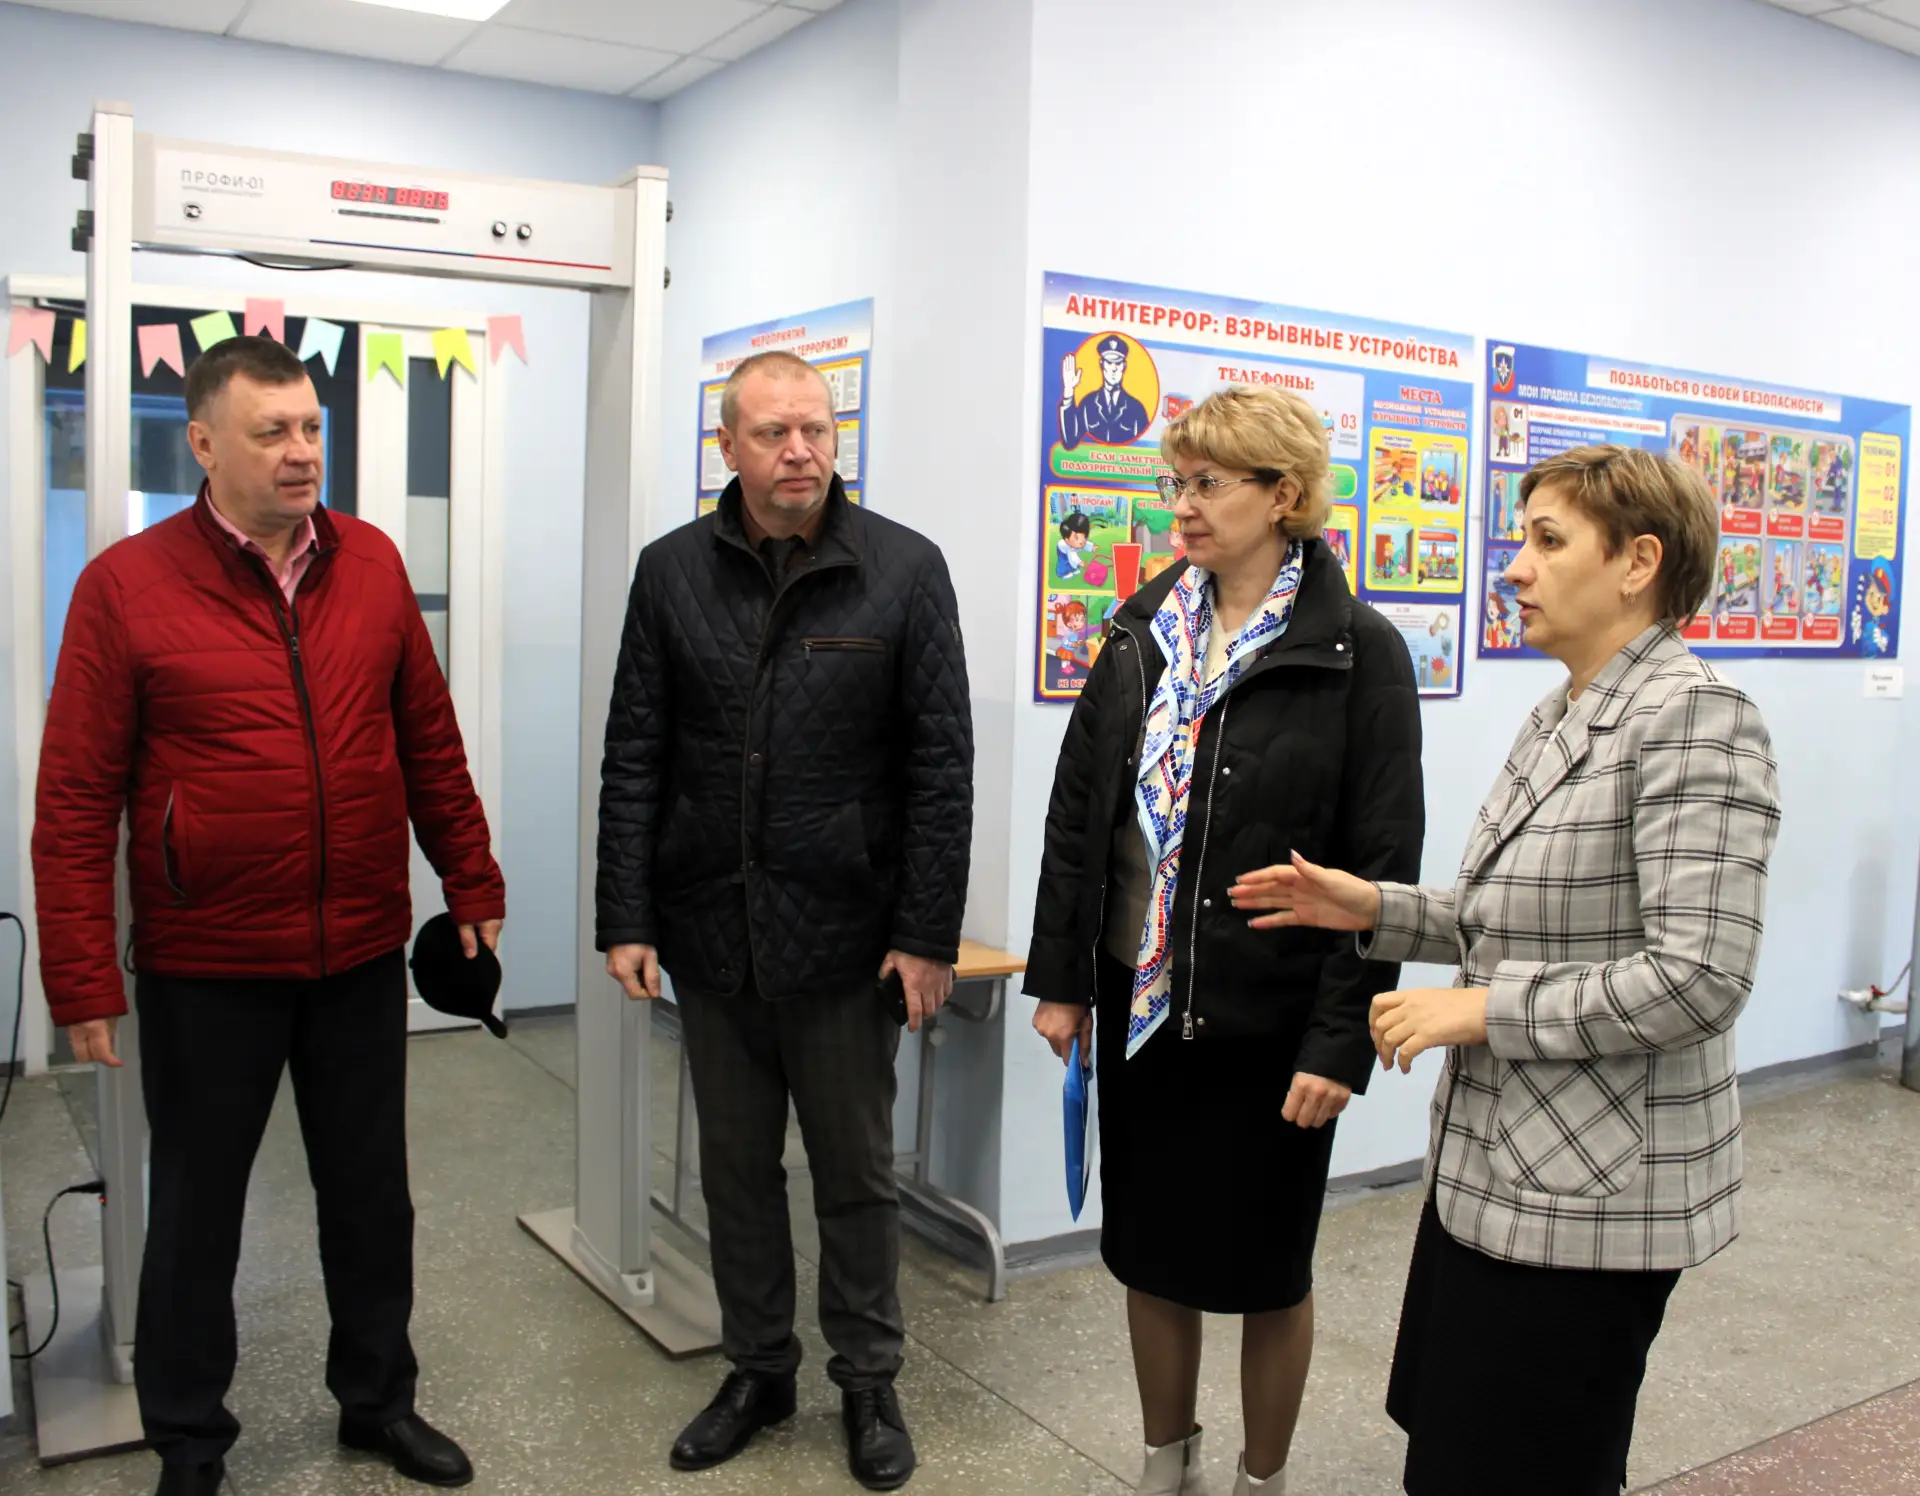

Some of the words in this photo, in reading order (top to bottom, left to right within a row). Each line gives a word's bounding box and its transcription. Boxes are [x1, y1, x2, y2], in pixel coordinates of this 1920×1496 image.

[181, 169, 264, 189] ПРОФИ-01
[1065, 294, 1218, 333] АНТИТЕРРОР:
[1225, 316, 1343, 350] ВЗРЫВНЫЕ
[1349, 334, 1459, 367] УСТРОЙСТВА
[1218, 366, 1315, 391] ТЕЛЕФОНЫ:
[1400, 386, 1443, 405] МЕСТА
[1609, 370, 1689, 395] ПОЗАБОТЬСЯ
[1692, 382, 1700, 396] О
[1743, 390, 1824, 413] БЕЗОПАСНОСТИ
[1341, 413, 1357, 430] 03
[1513, 407, 1523, 419] 01
[1090, 451, 1116, 462] ЕСЛИ
